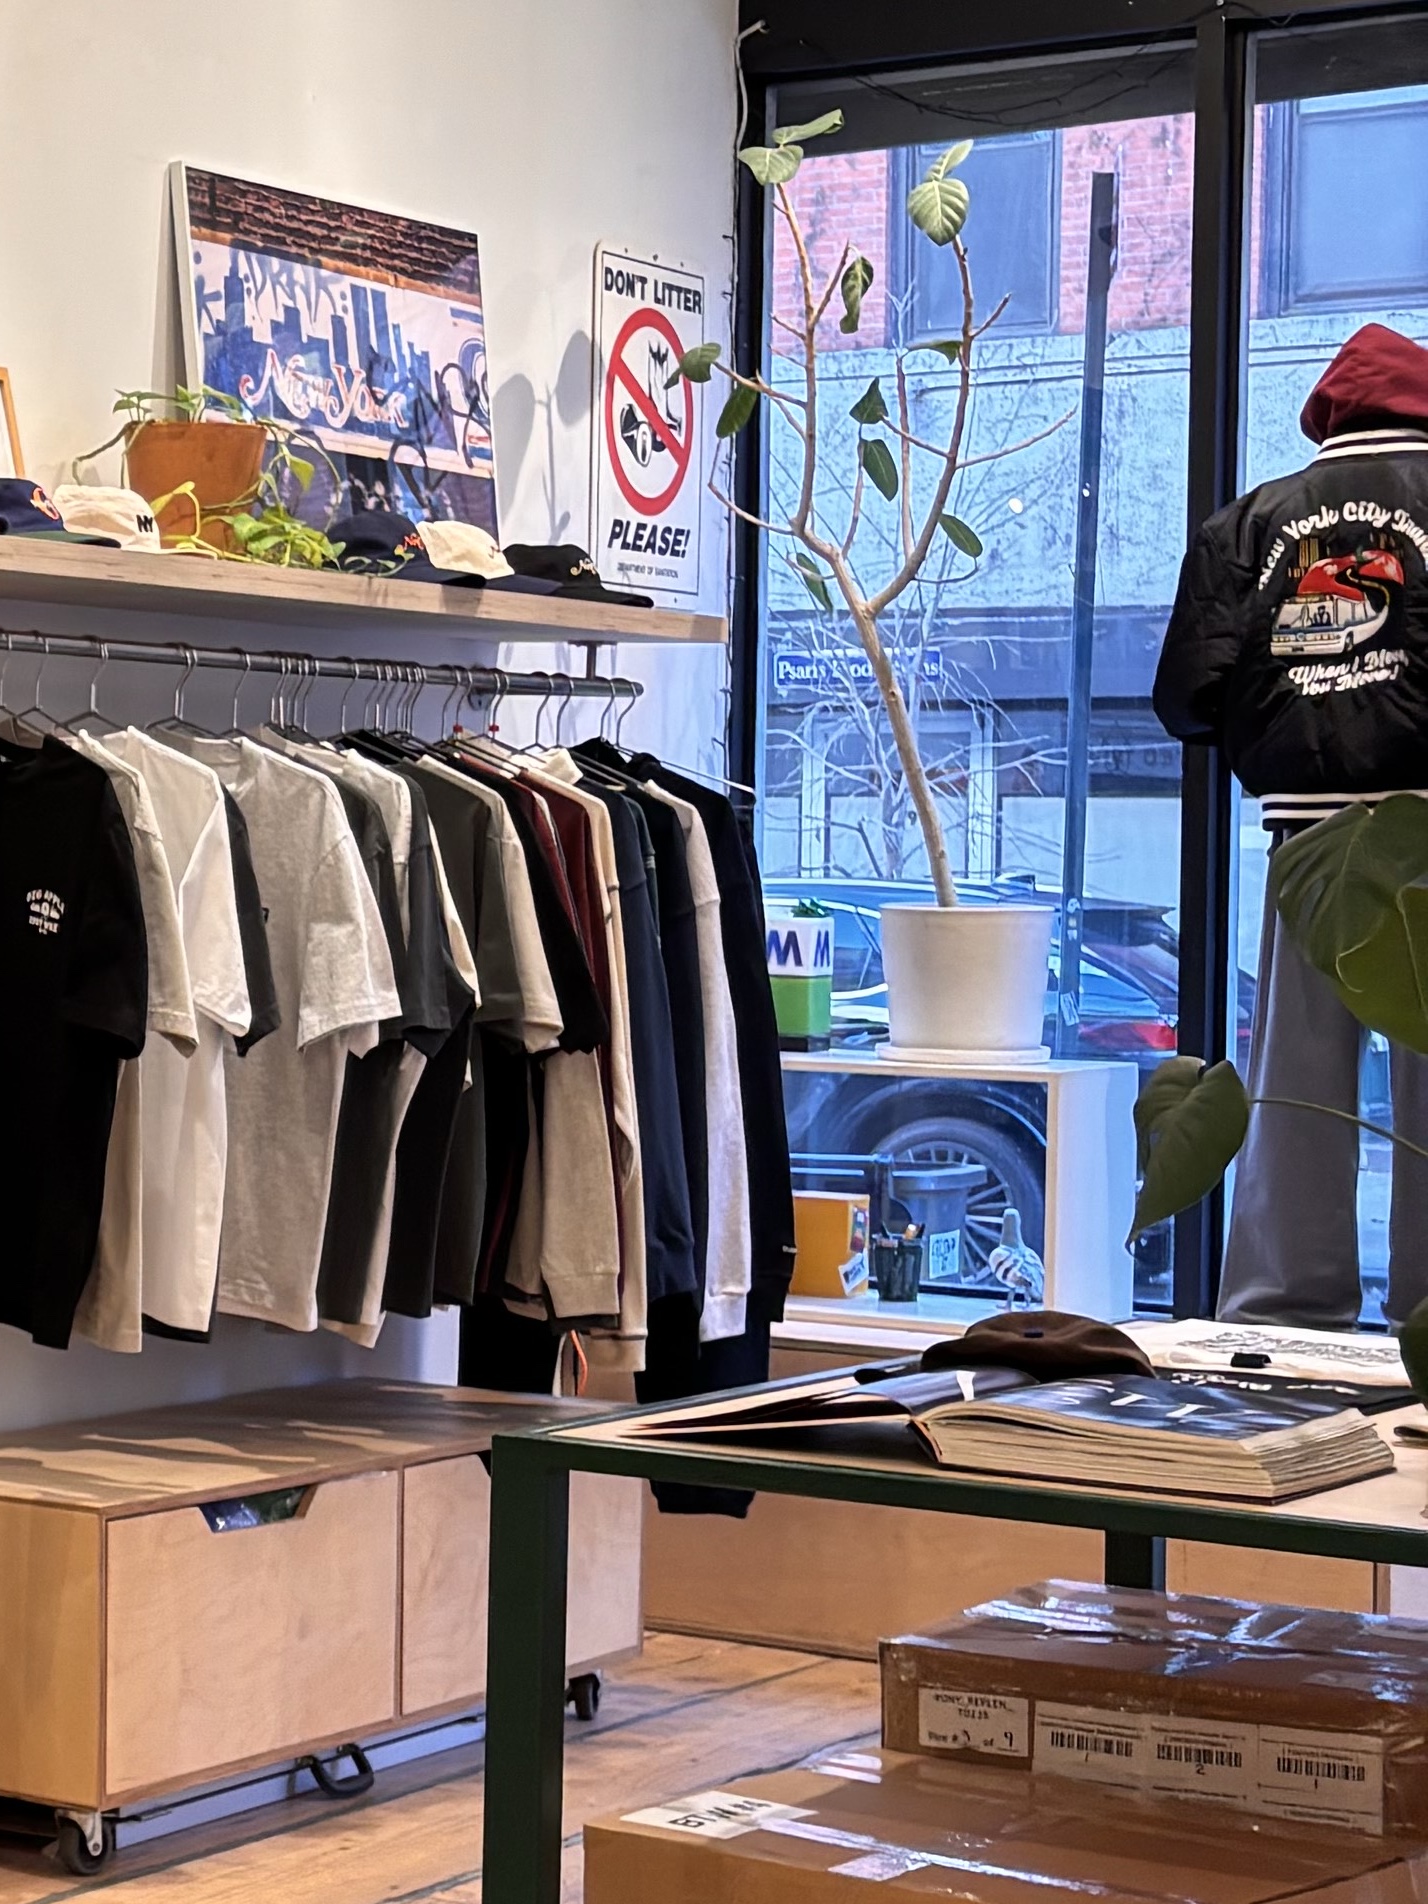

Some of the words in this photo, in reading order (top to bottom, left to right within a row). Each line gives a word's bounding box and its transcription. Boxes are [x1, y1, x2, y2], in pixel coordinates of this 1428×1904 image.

[654, 279, 702, 315] LITTER
[607, 518, 691, 558] PLEASE!
[1282, 505, 1340, 540] York
[1342, 500, 1392, 528] City
